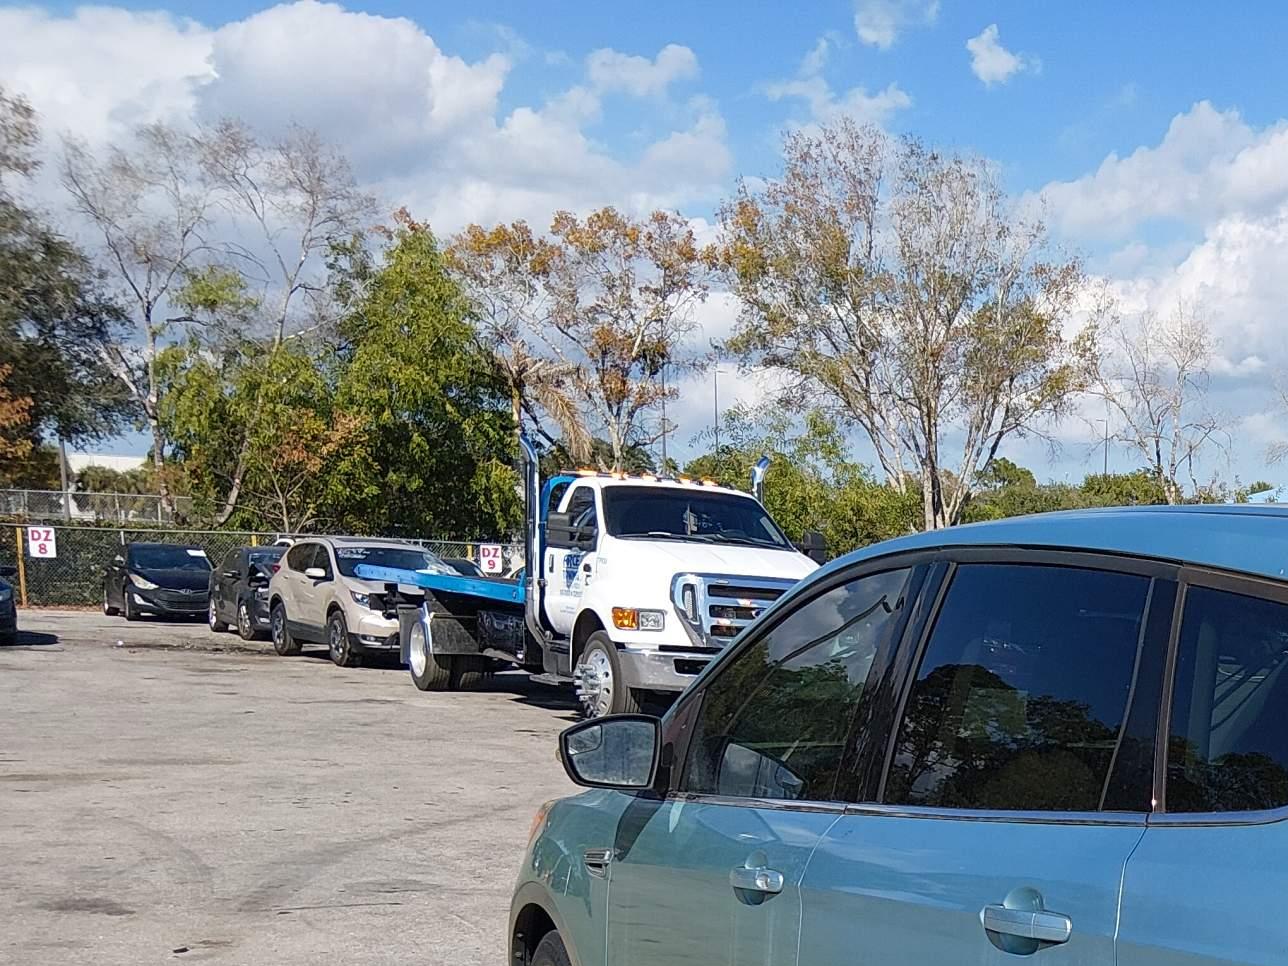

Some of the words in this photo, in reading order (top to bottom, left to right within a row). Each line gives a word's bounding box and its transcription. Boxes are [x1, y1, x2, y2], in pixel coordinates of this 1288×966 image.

[31, 529, 53, 541] DZ
[38, 543, 48, 554] 8
[481, 547, 500, 558] DZ
[487, 560, 496, 569] 9
